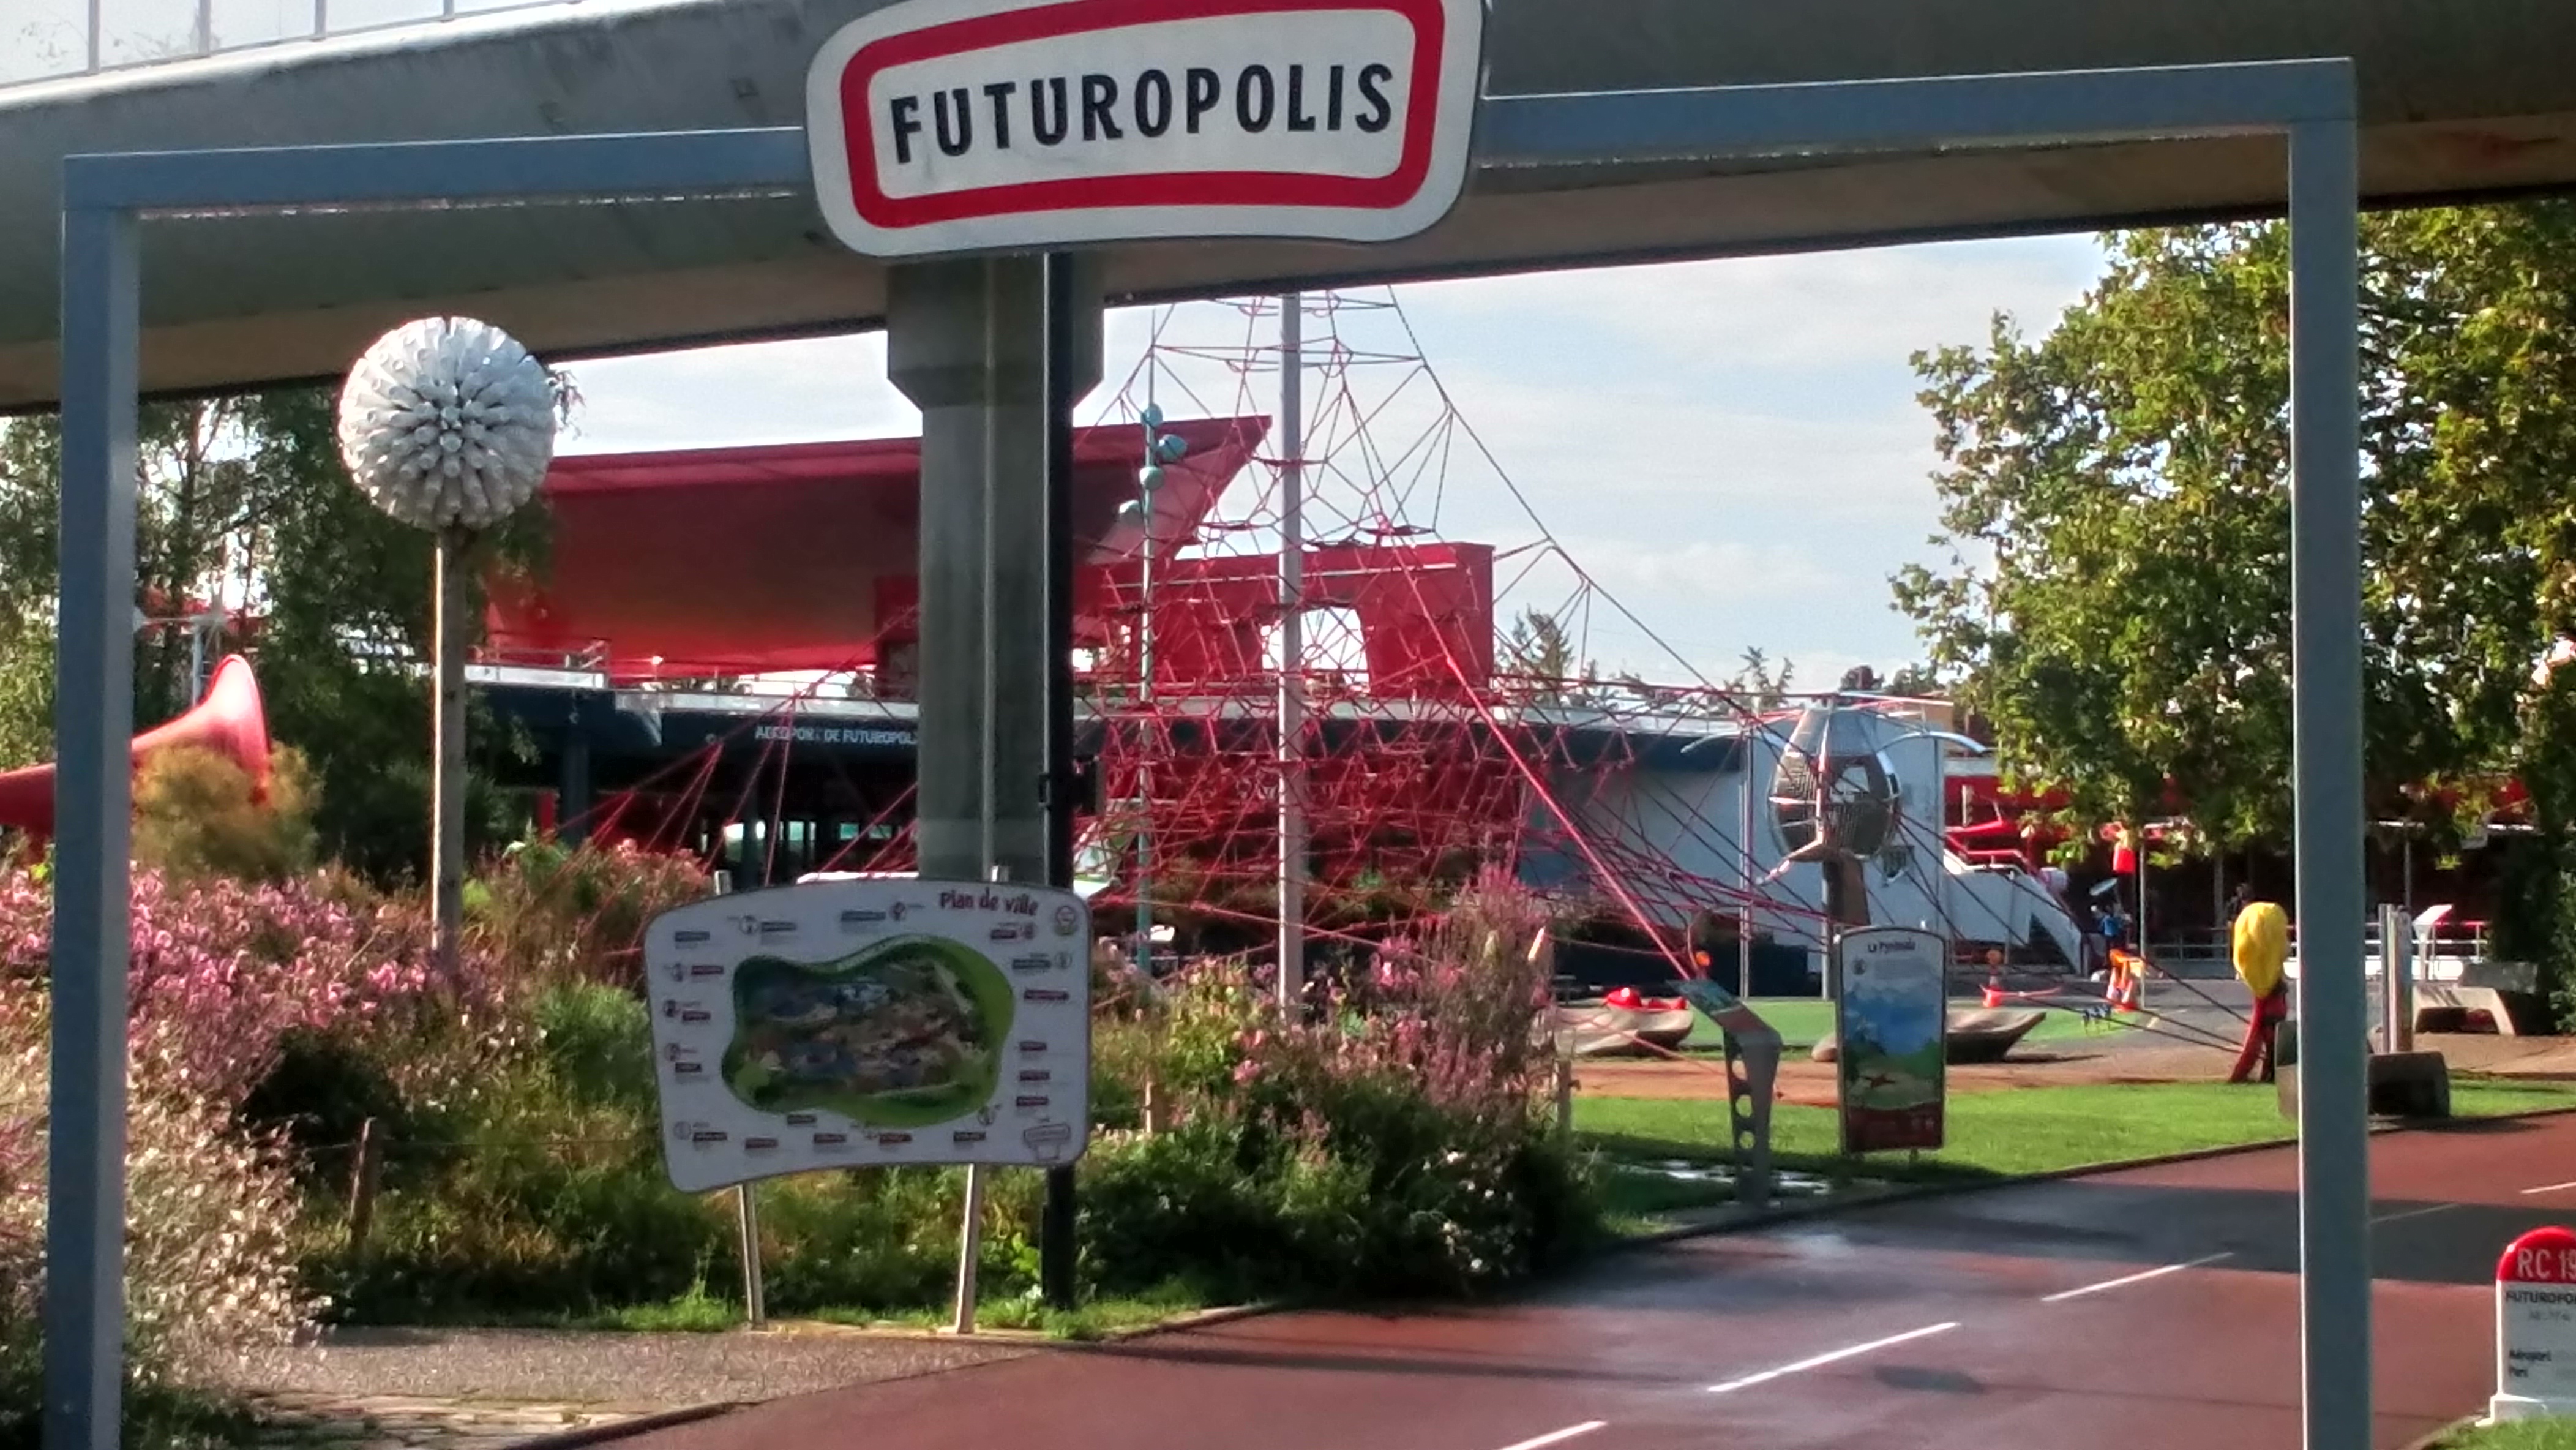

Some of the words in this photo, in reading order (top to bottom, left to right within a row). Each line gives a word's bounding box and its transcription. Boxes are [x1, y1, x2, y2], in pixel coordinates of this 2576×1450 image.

[891, 62, 1394, 164] FUTUROPOLIS
[824, 728, 841, 743] DE
[940, 890, 974, 909] Plan
[979, 887, 998, 911] de
[1005, 894, 1039, 916] ville
[2517, 1249, 2551, 1279] RC
[2506, 1290, 2576, 1304] FUTUROPO
